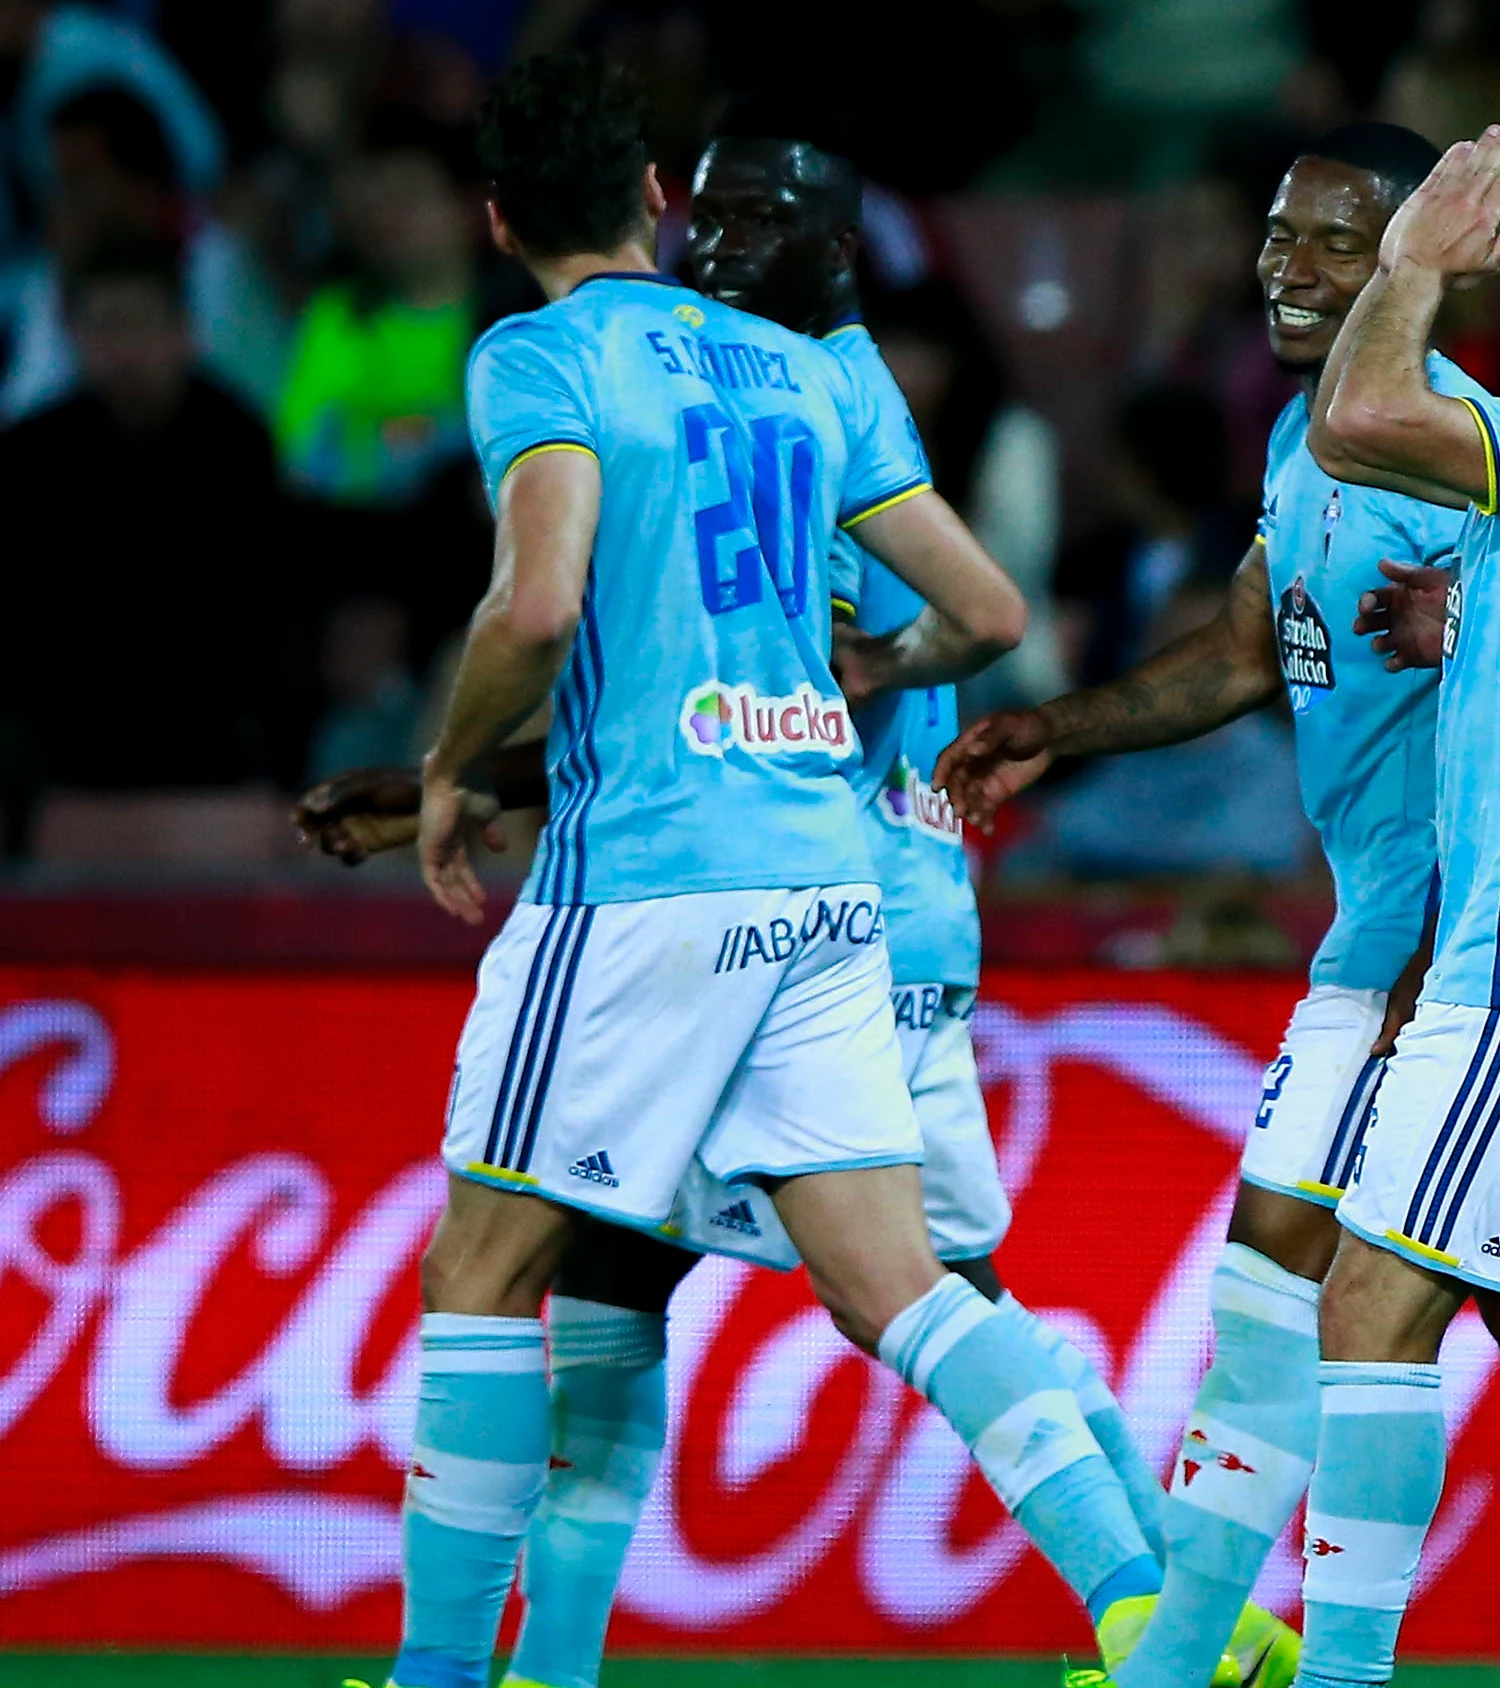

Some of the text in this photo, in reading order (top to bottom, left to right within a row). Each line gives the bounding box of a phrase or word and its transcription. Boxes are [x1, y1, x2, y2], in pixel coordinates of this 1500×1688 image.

[681, 401, 815, 619] 20
[1283, 613, 1328, 651] strella
[1286, 648, 1329, 685] alicia
[739, 693, 847, 747] lucka
[568, 1165, 620, 1189] adidas
